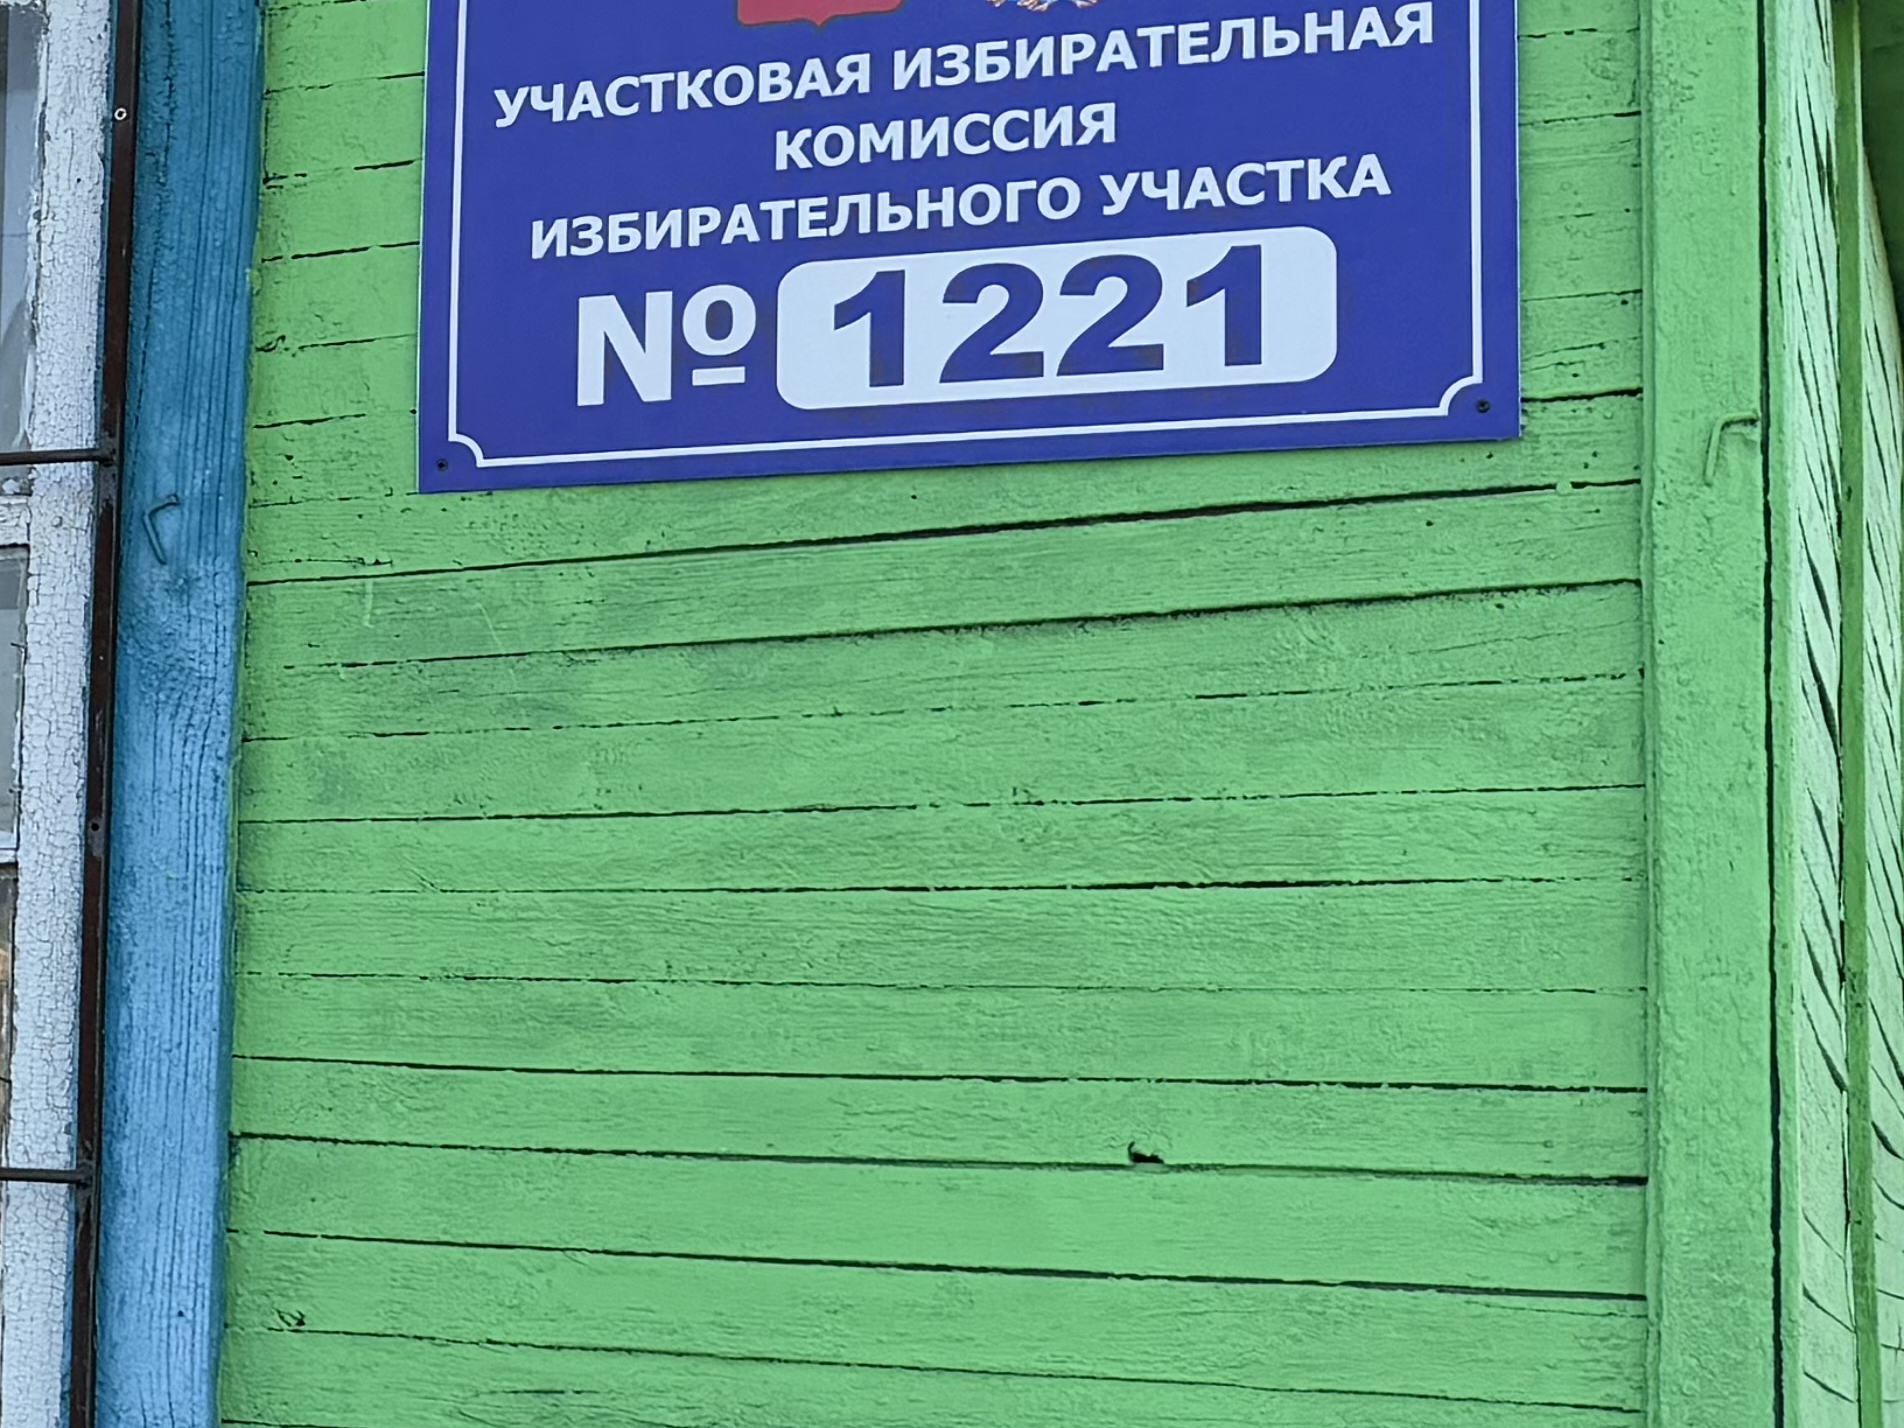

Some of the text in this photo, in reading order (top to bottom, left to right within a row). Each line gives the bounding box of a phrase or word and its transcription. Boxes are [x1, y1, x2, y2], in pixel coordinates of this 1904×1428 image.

[493, 0, 1434, 129] УЧАСТКОВАЯ ИЗБИРАТЕЛЬНАЯ
[774, 101, 1117, 172] КОМИССИЯ
[530, 152, 1393, 261] ИЗБИРАТЕЛЬНОГО УЧАСТКА
[576, 243, 1265, 408] № 1221
